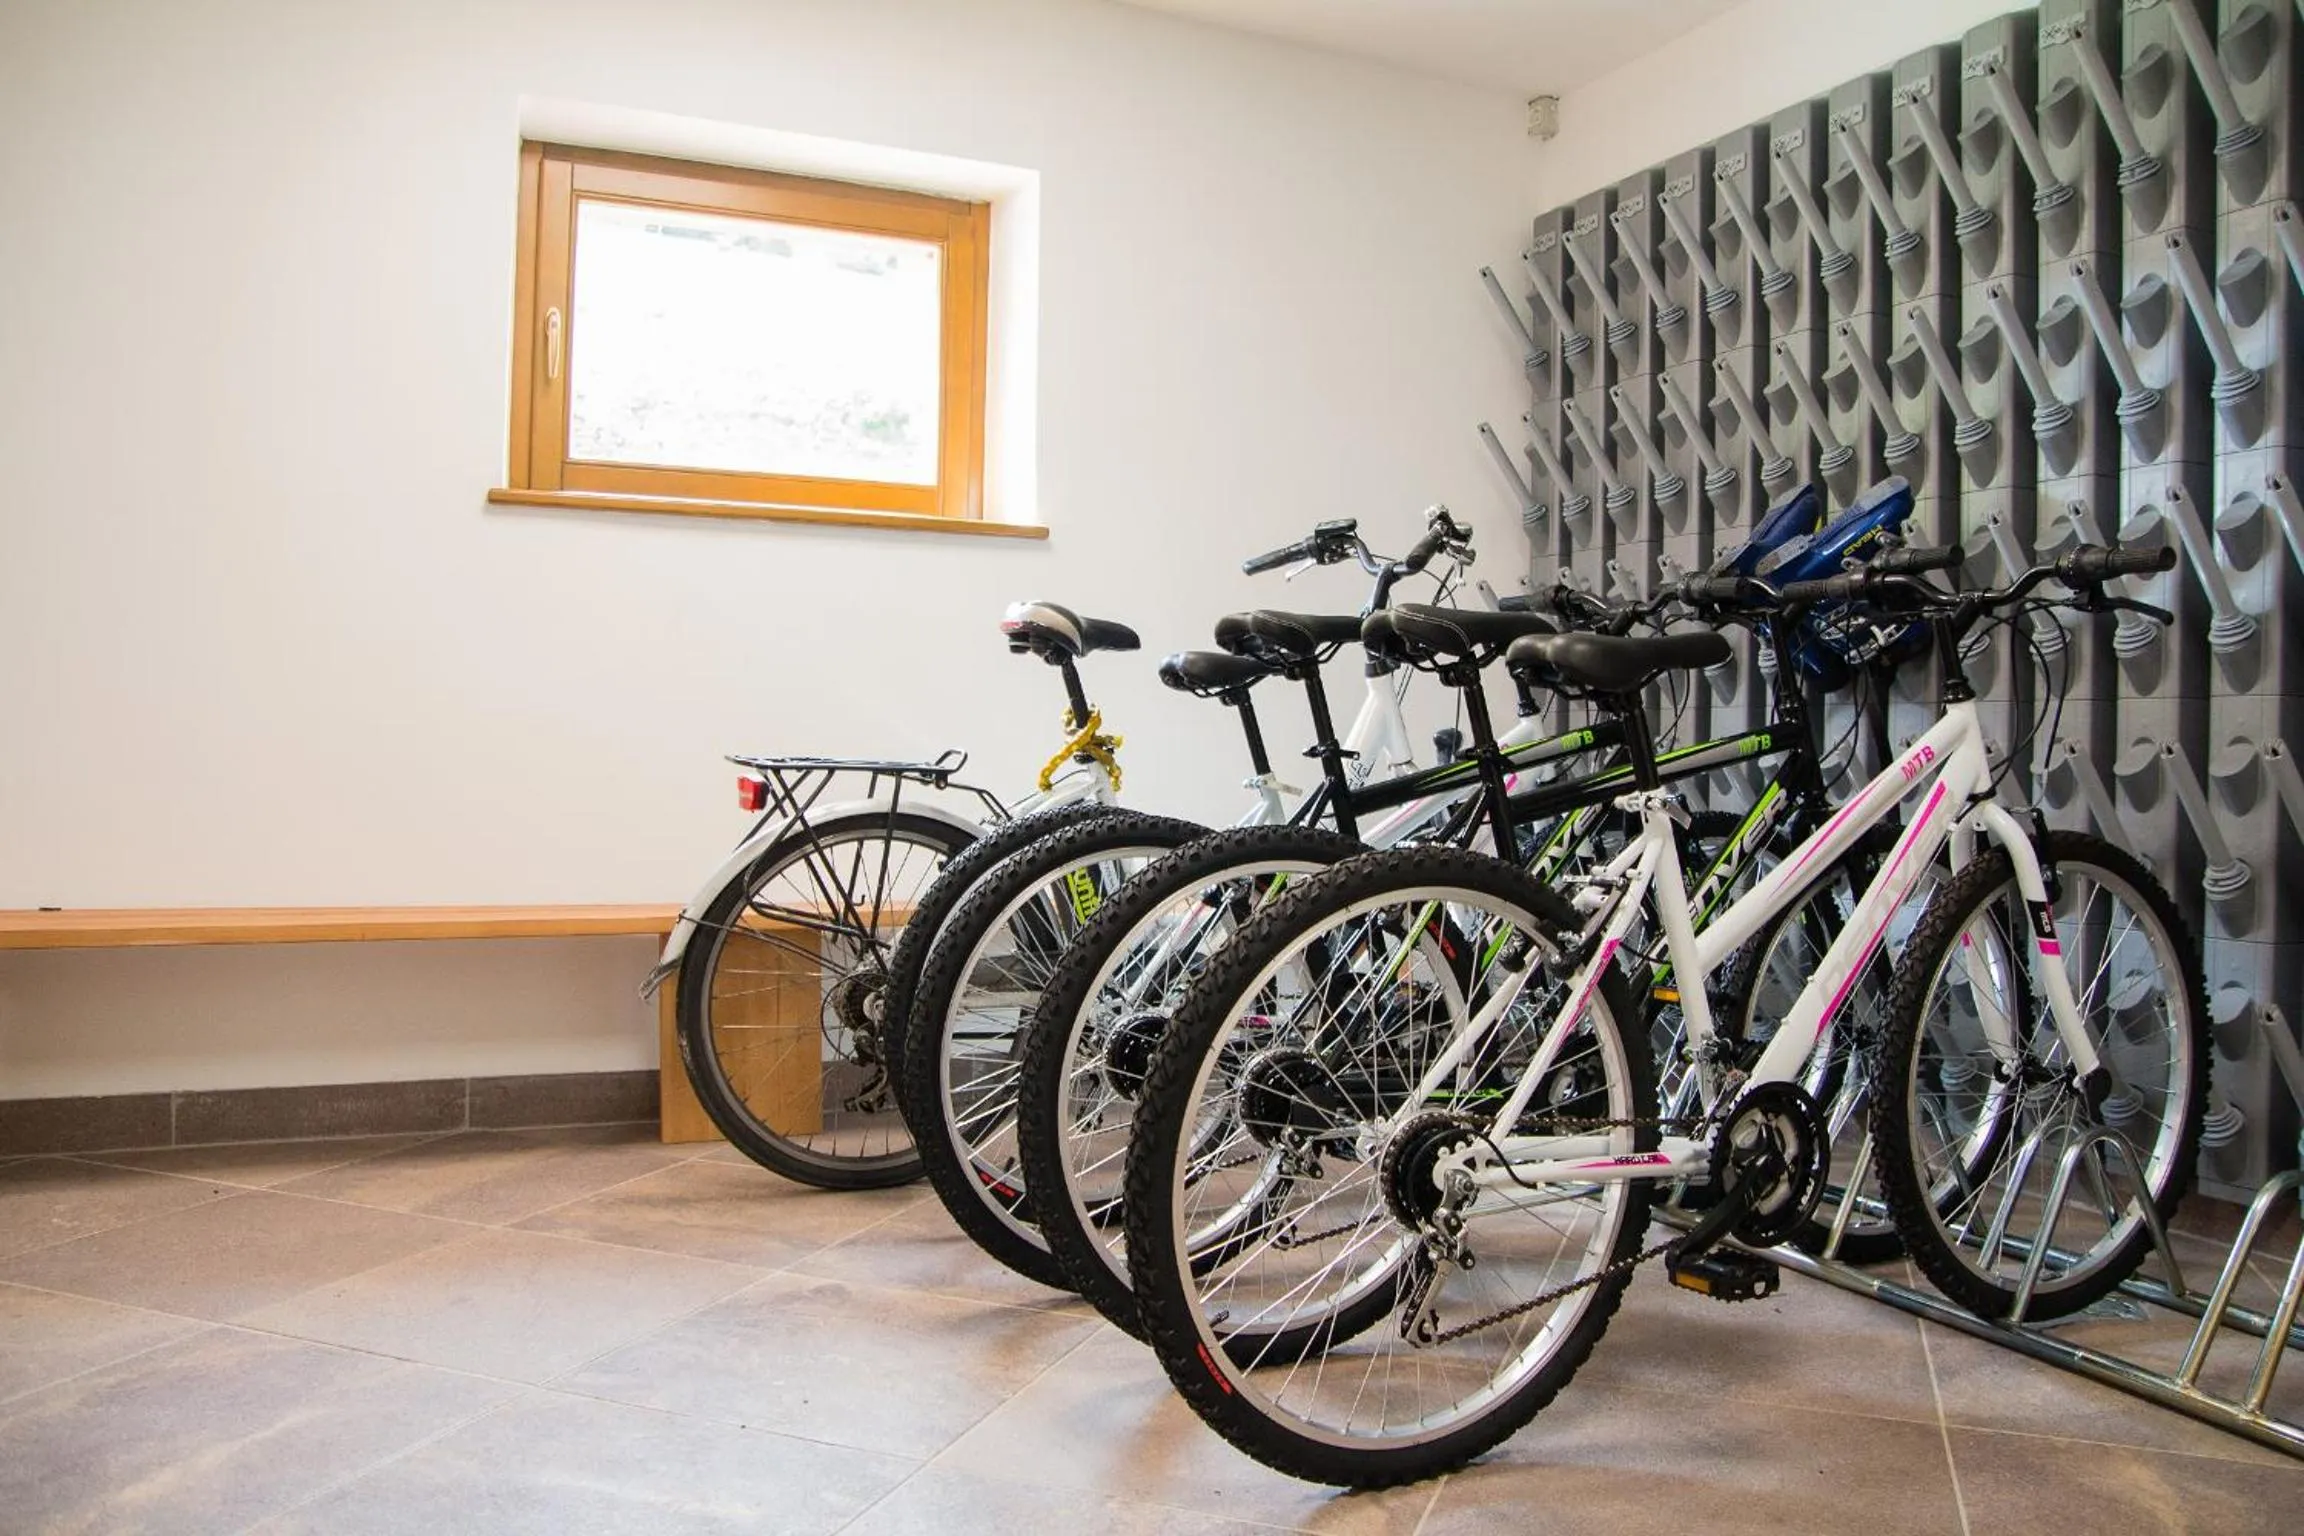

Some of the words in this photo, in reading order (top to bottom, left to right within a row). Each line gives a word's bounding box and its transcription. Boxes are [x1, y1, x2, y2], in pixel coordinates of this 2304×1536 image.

[1843, 524, 1882, 556] HEAD
[1738, 734, 1771, 757] MTB
[1901, 745, 1935, 782] MTB
